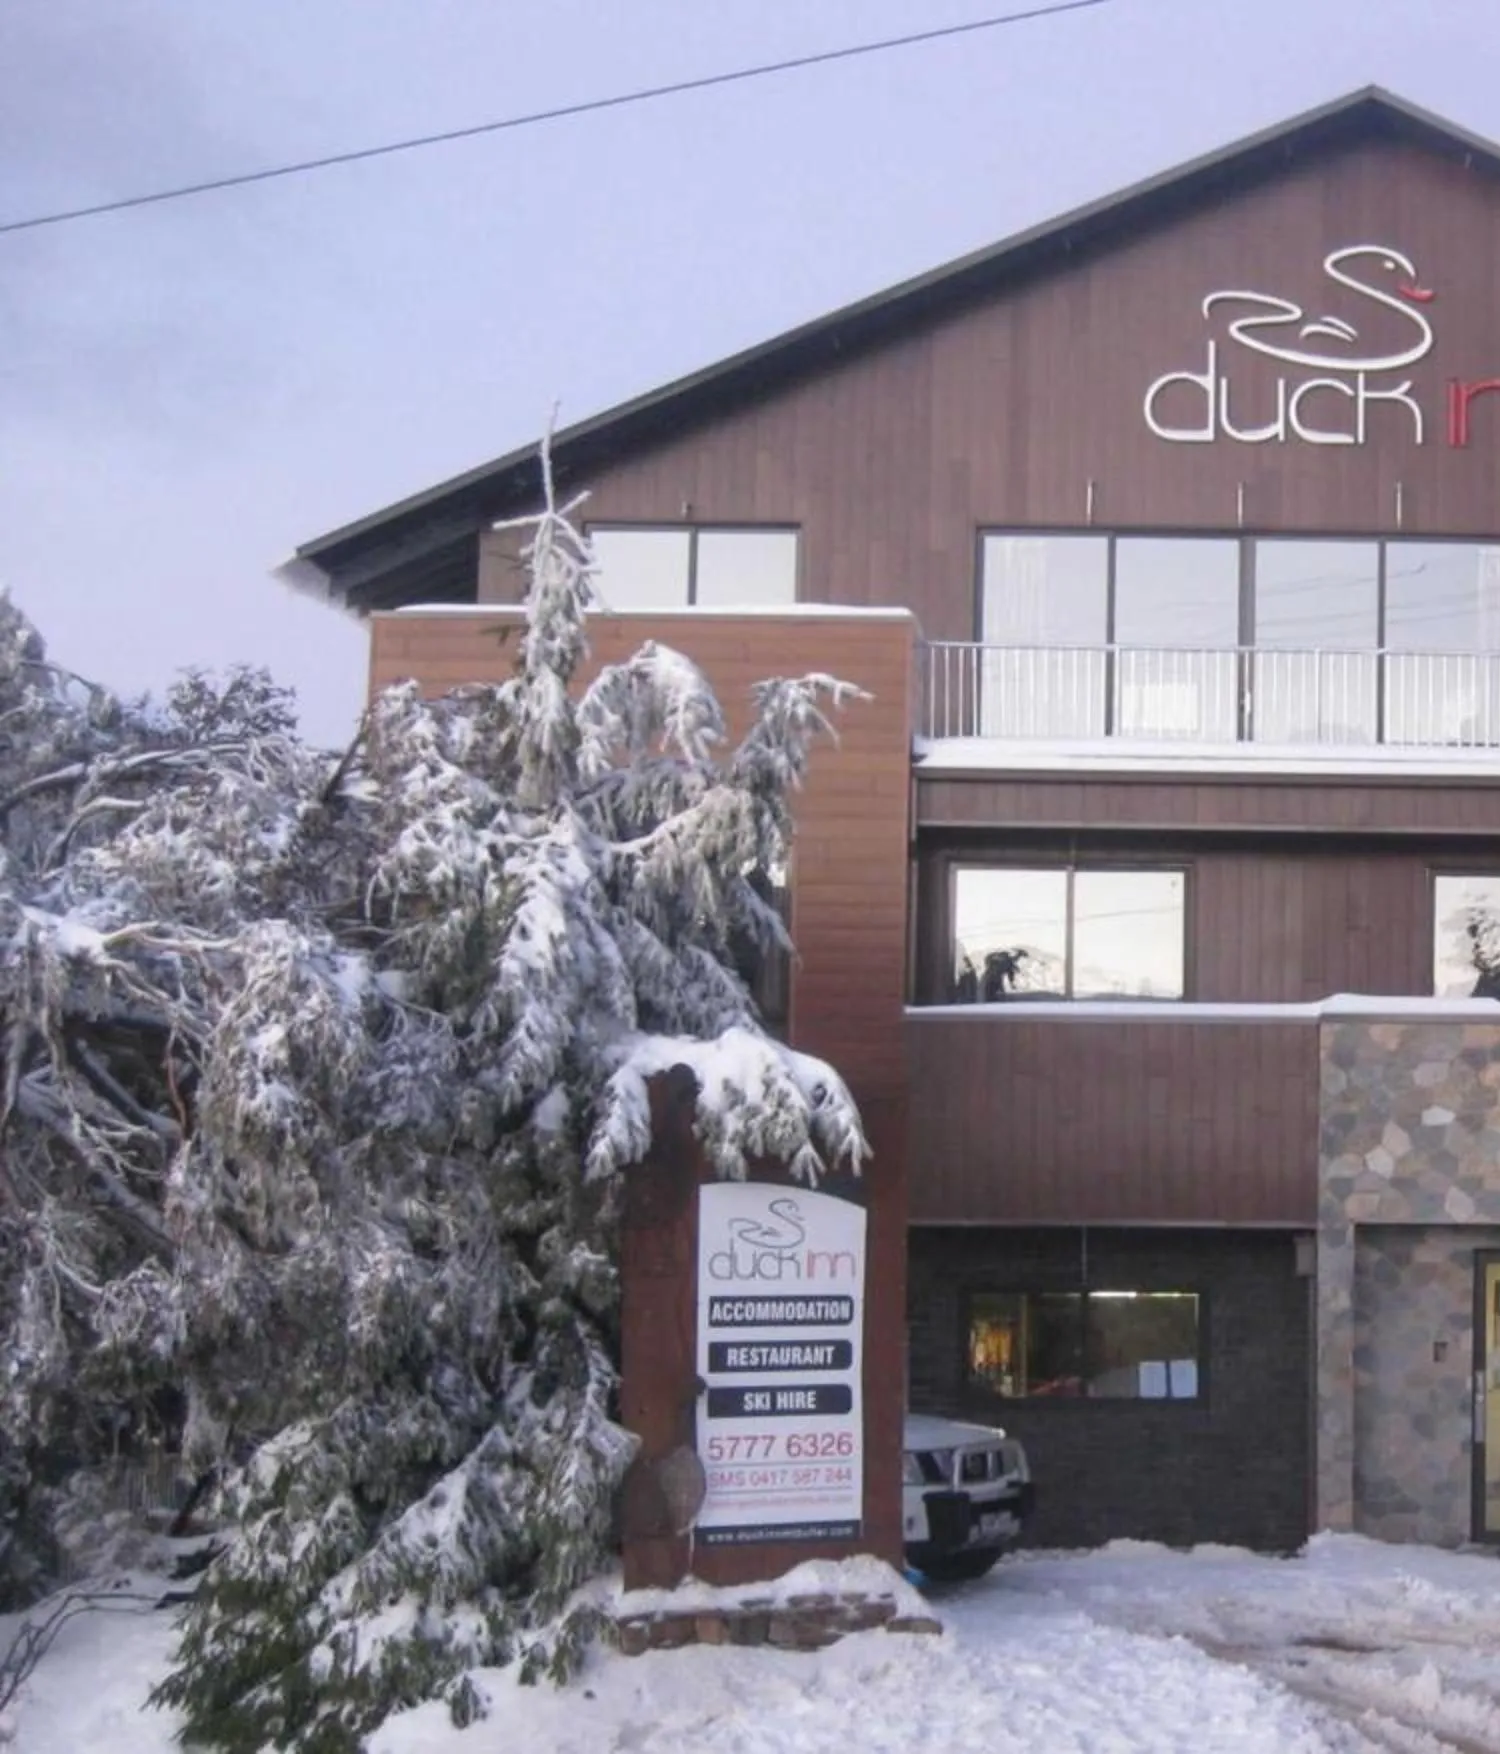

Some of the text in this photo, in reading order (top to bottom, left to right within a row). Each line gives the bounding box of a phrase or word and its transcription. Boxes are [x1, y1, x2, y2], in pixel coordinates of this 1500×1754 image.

[1143, 340, 1423, 444] duck
[708, 1238, 856, 1280] duck inn
[711, 1300, 850, 1322] ACCOMMODATION
[726, 1345, 836, 1368] RESTAURANT
[743, 1391, 817, 1412] SKI HIRE
[708, 1431, 853, 1461] 5777 6326
[708, 1469, 746, 1488] SMS
[750, 1468, 789, 1487] 0417
